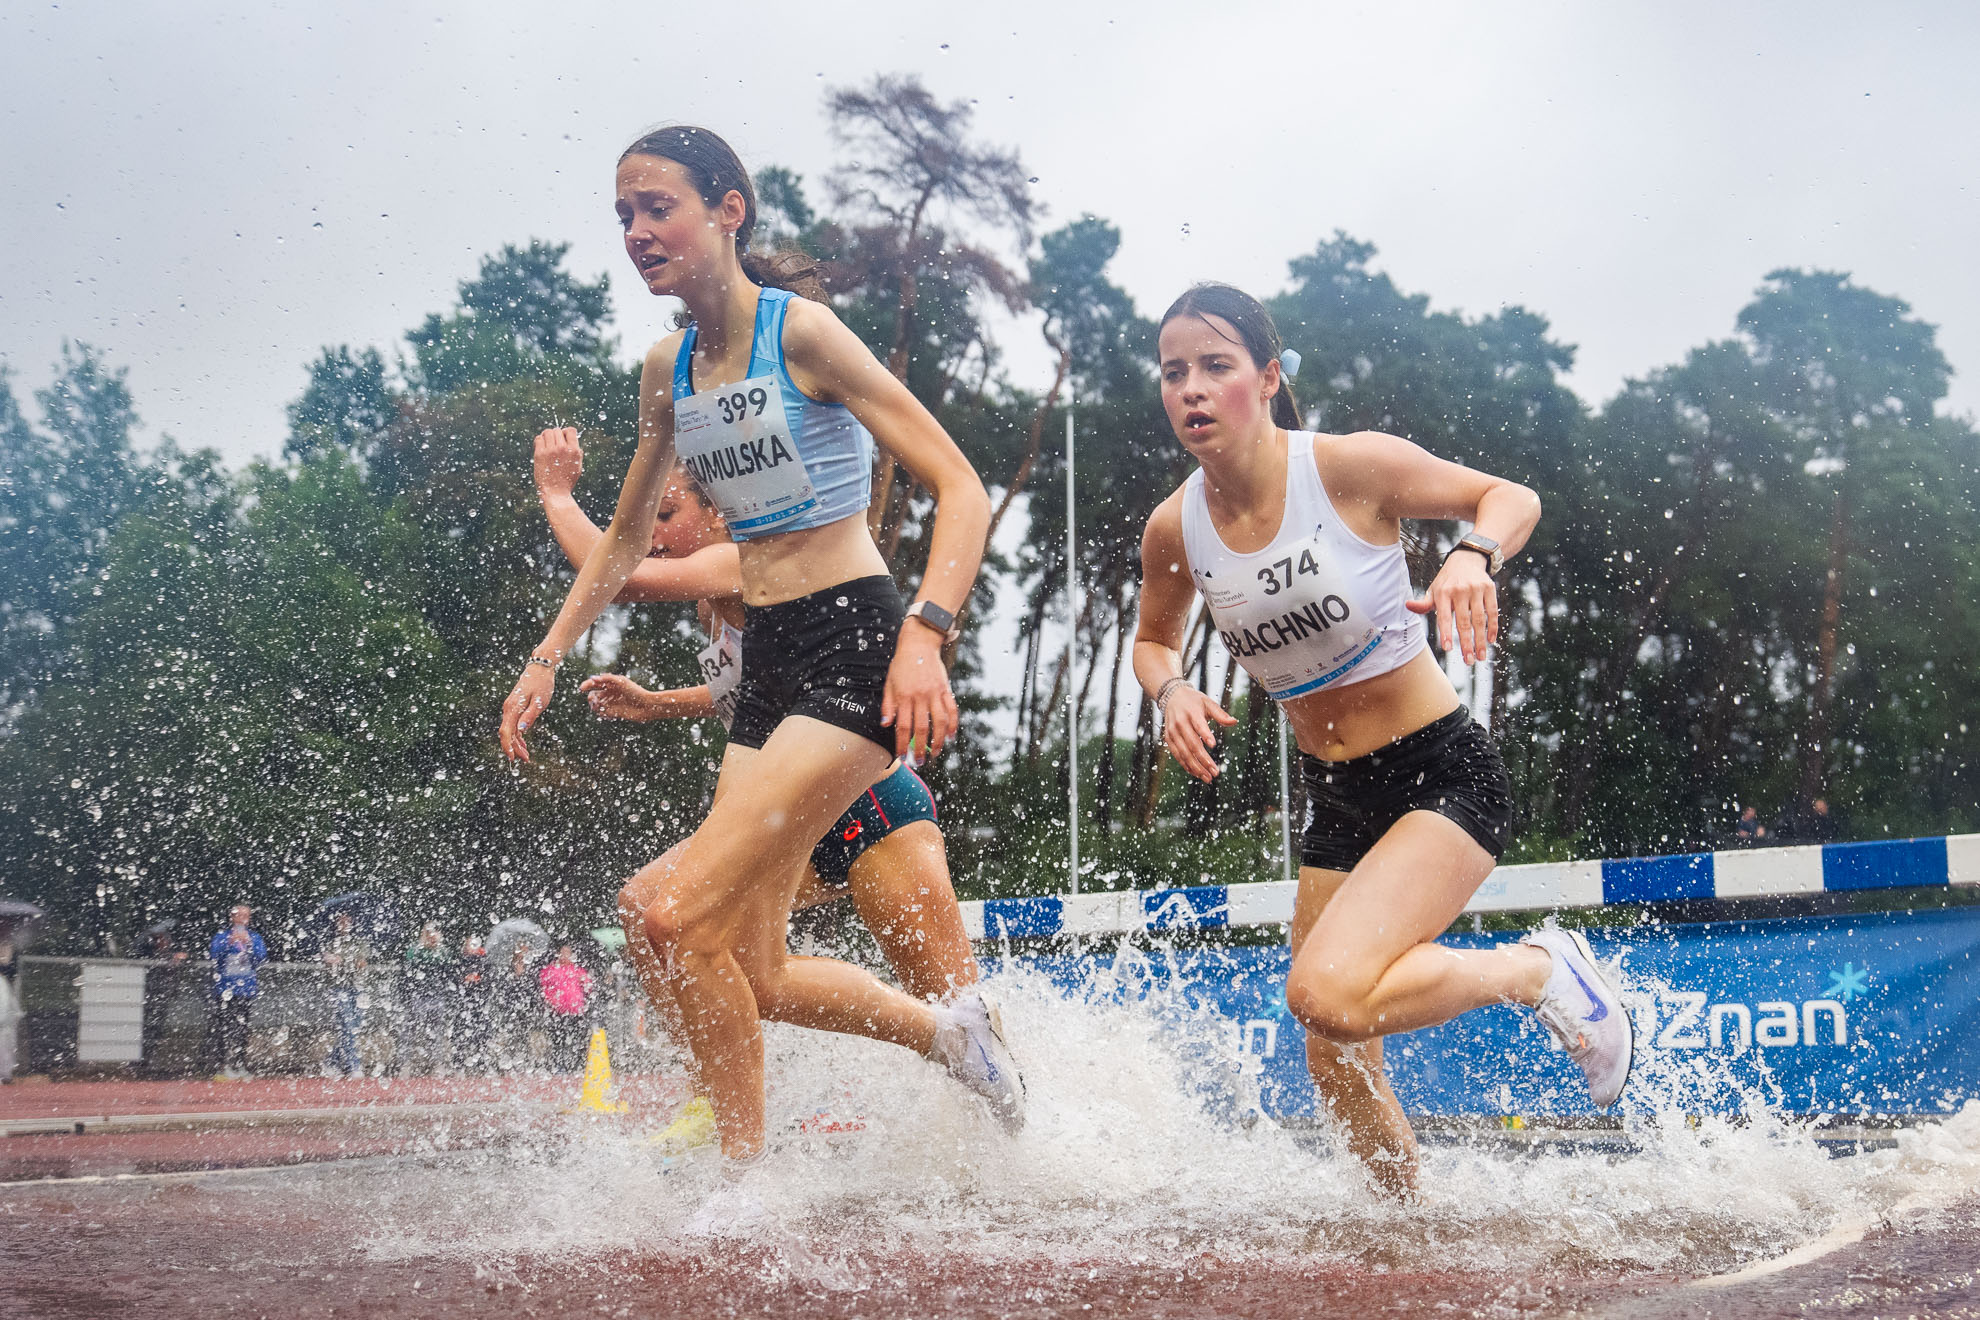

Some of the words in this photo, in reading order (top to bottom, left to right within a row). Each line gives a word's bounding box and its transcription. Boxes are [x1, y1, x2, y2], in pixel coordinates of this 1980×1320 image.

[717, 387, 768, 425] 399
[1257, 548, 1319, 596] 374
[1220, 594, 1350, 658] BŁACHNIO
